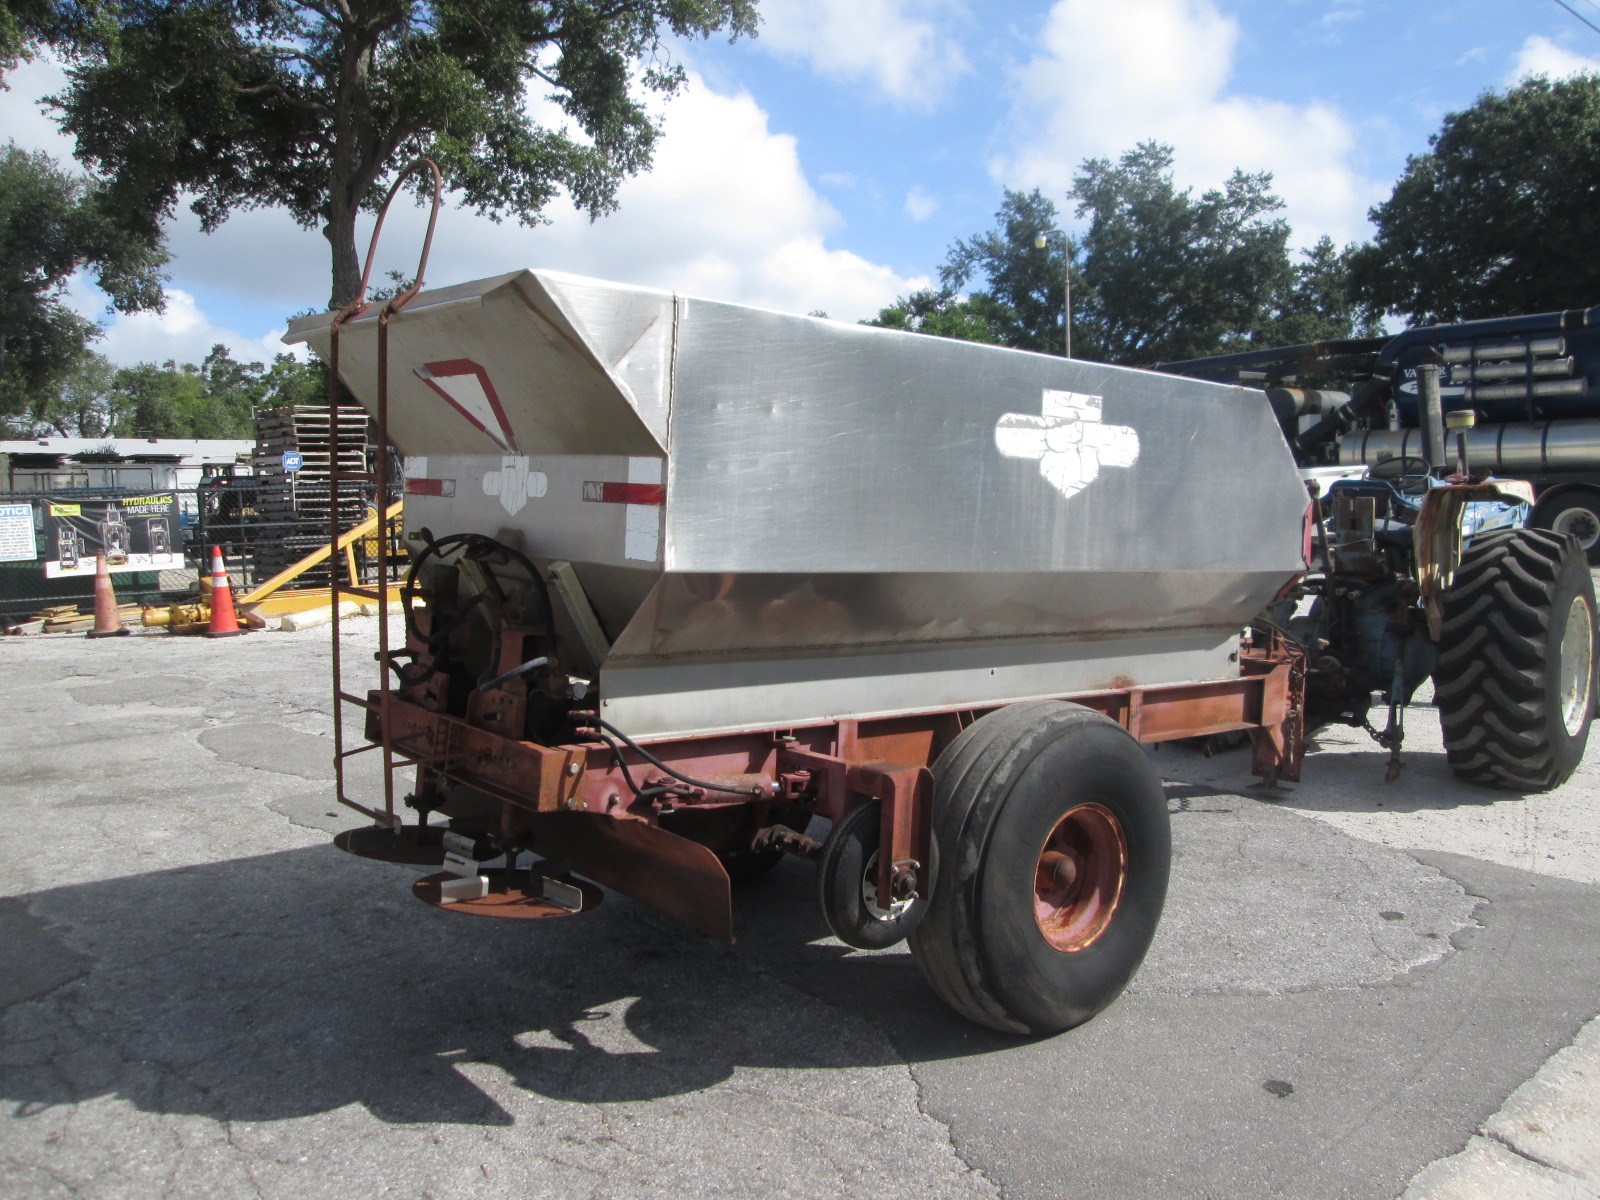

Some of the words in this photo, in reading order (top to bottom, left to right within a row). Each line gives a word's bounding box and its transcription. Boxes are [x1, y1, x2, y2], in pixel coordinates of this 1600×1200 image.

[286, 457, 299, 465] ADT
[122, 496, 173, 506] HYDRAULICS
[127, 506, 150, 514] MADE
[151, 504, 170, 513] HERE
